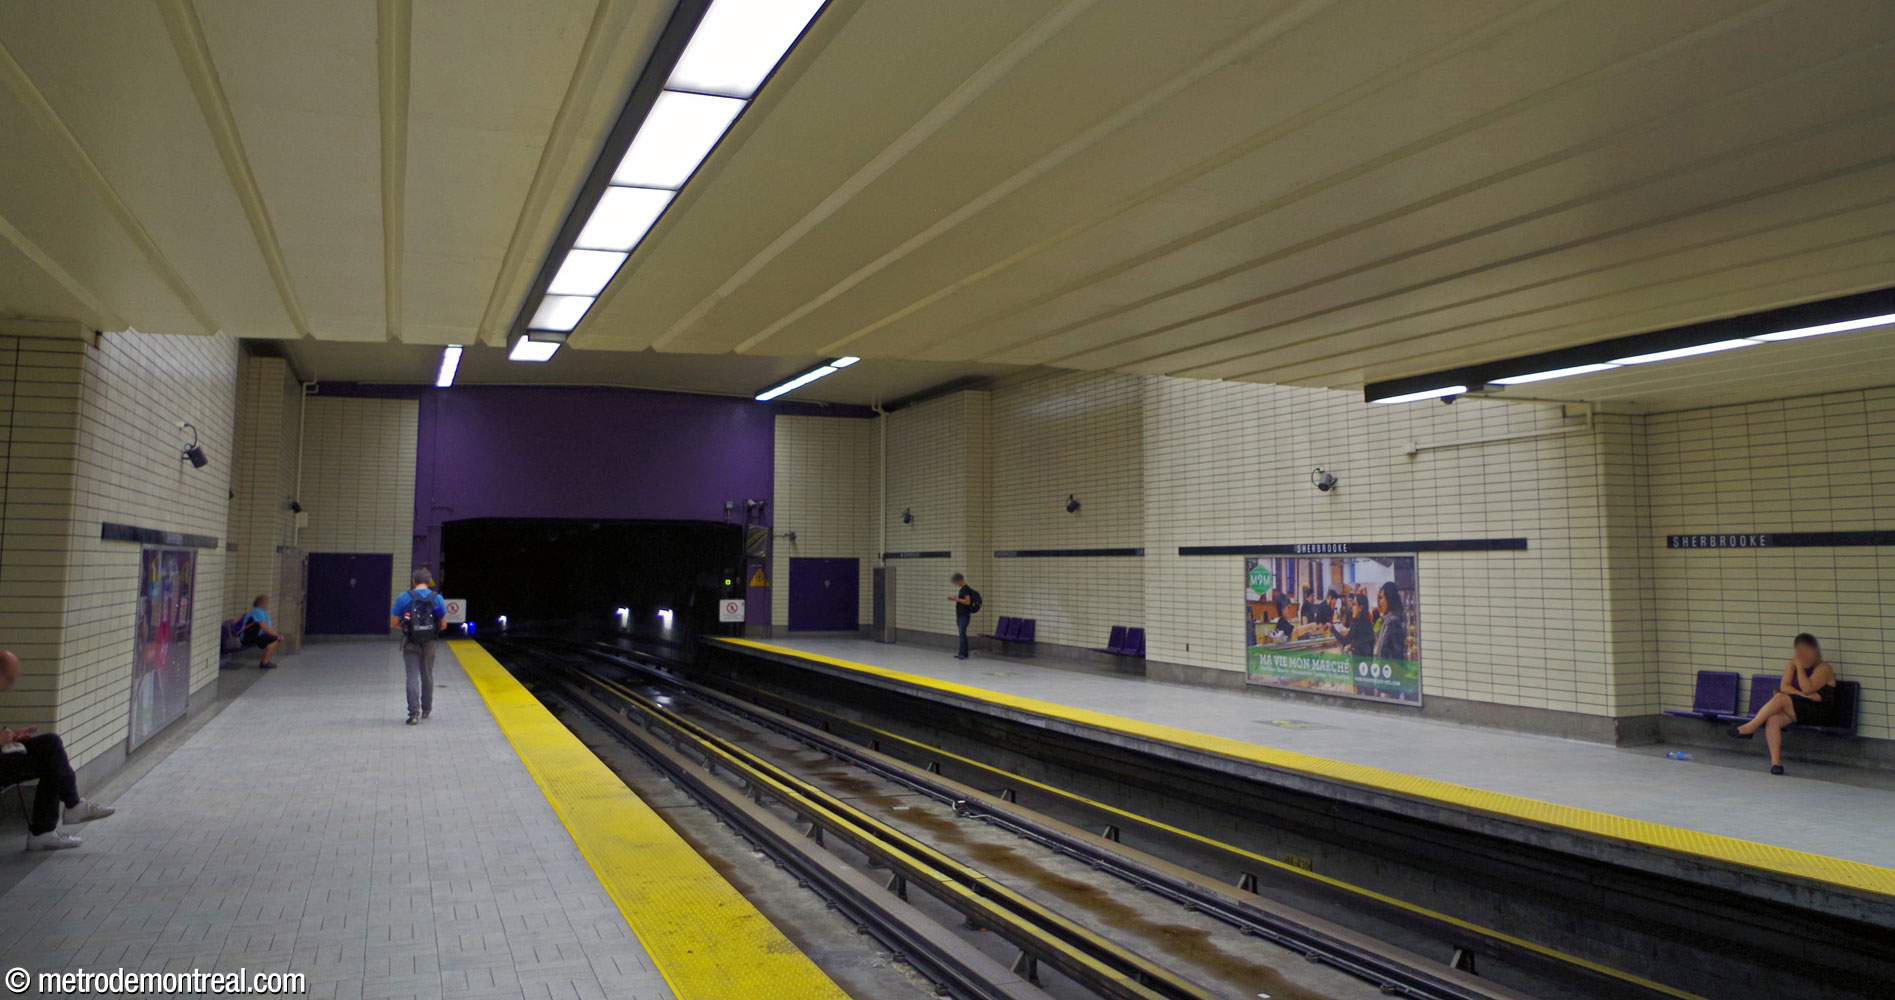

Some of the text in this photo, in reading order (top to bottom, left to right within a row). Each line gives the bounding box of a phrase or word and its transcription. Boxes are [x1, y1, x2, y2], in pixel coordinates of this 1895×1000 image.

[1672, 535, 1766, 547] SHERBROOKE
[1297, 543, 1347, 553] SHERBROOKE
[1259, 654, 1272, 665] MA
[1274, 655, 1288, 667] VIE
[1289, 657, 1310, 669] MON
[1312, 658, 1350, 673] MARCHÉ
